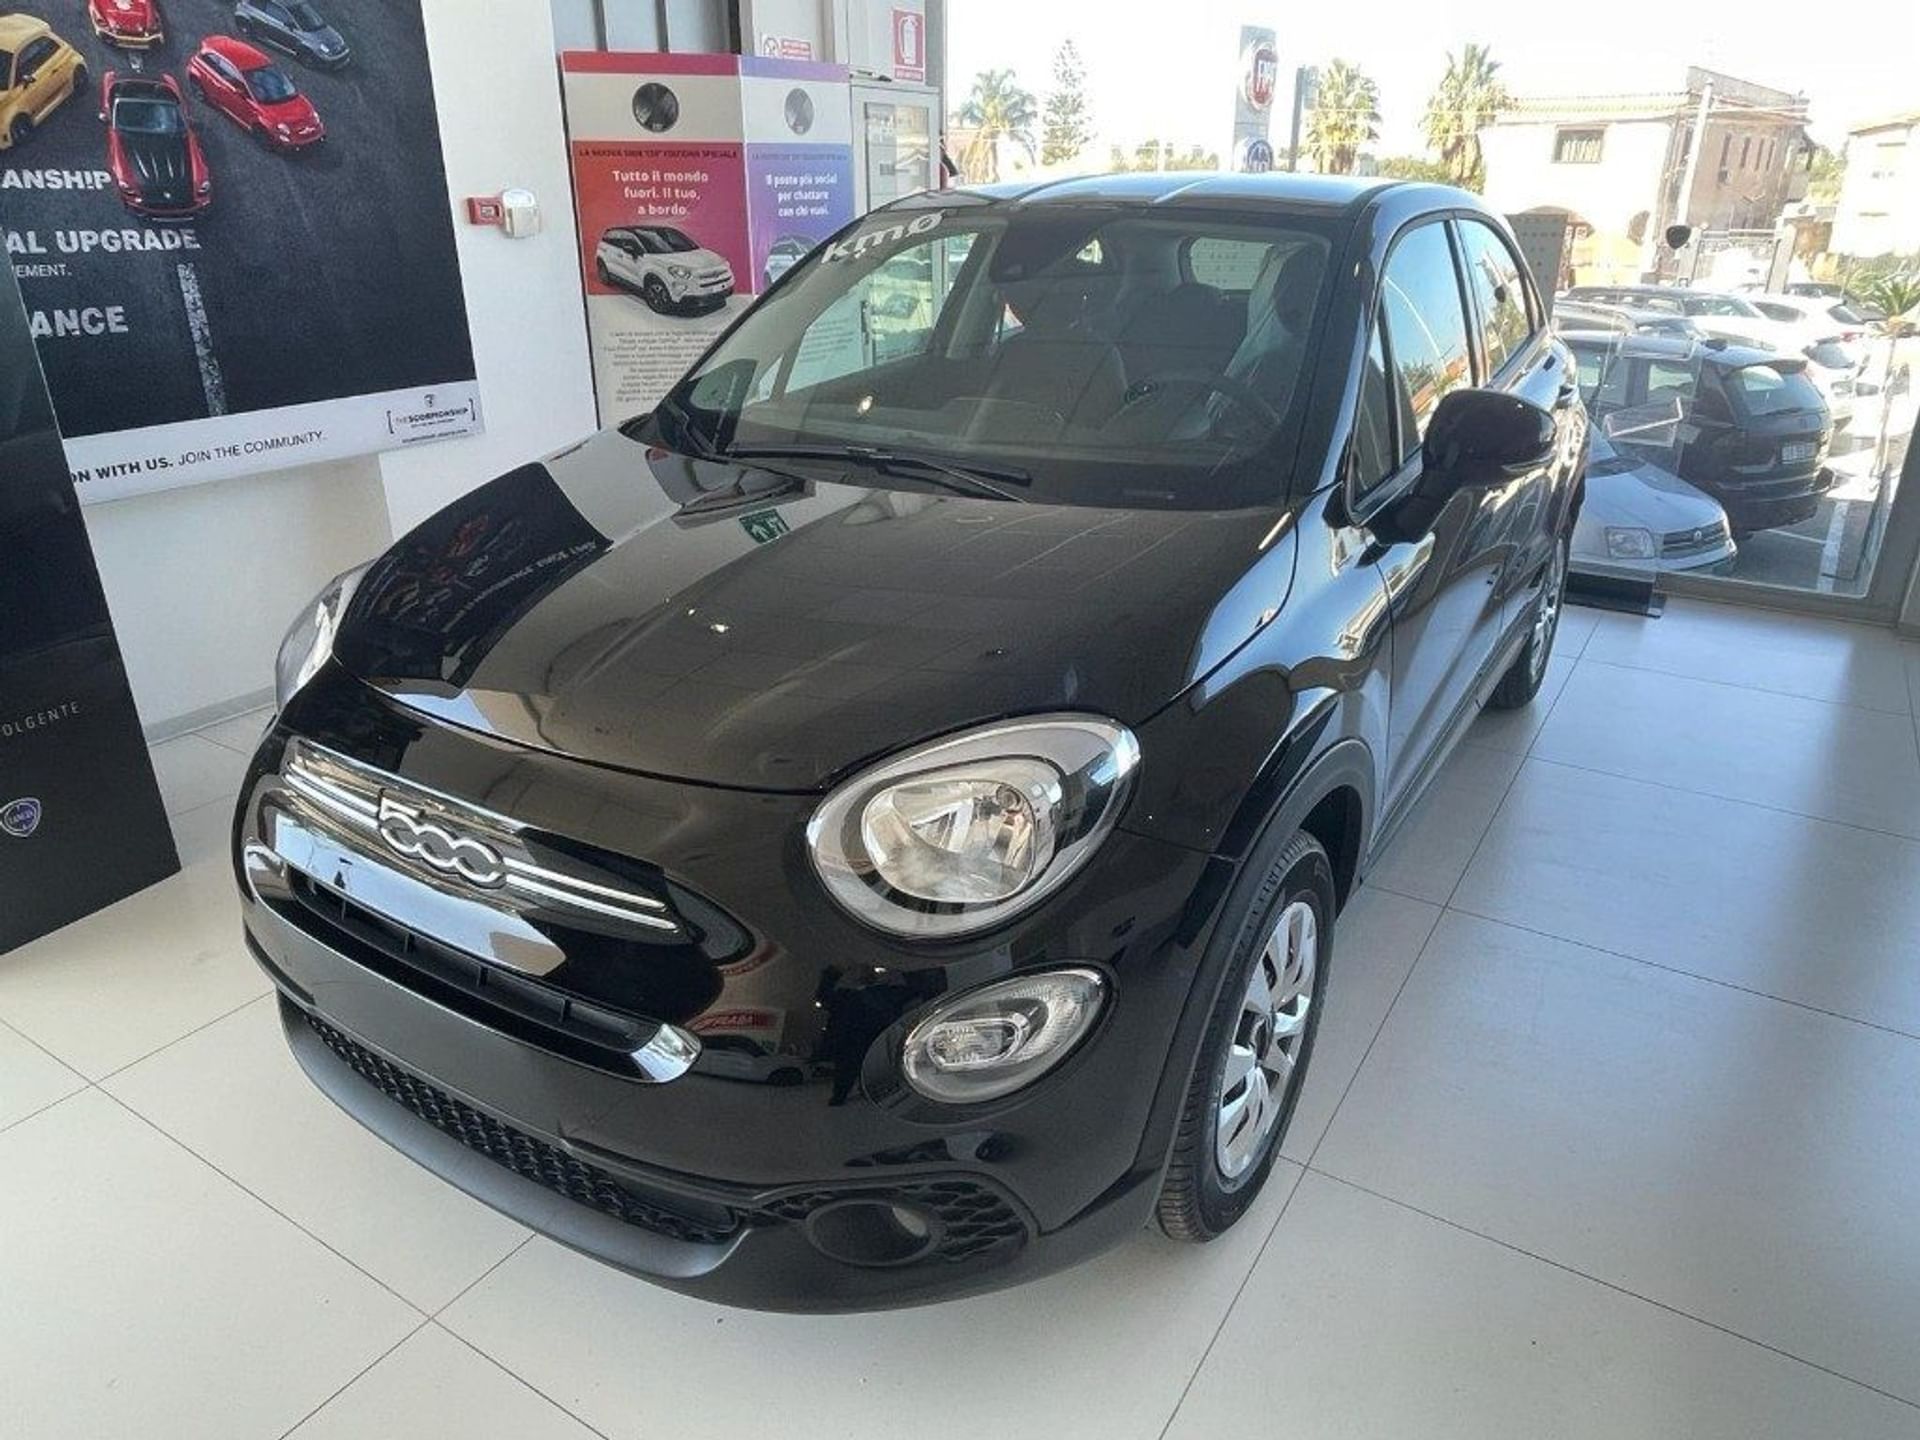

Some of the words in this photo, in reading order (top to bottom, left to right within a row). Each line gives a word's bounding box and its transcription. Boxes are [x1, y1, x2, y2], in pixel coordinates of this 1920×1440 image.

[1, 169, 112, 190] ANSHIP
[612, 170, 649, 182] Tutto
[663, 171, 709, 182] mondo
[637, 206, 646, 215] a
[55, 229, 202, 253] UPGRADE
[30, 305, 129, 339] ANCE
[96, 461, 142, 480] WITH
[146, 457, 174, 471] US.
[178, 450, 212, 467] JOIN
[215, 444, 242, 459] THE
[2, 701, 80, 737] OLGENTE
[379, 795, 503, 886] 500
